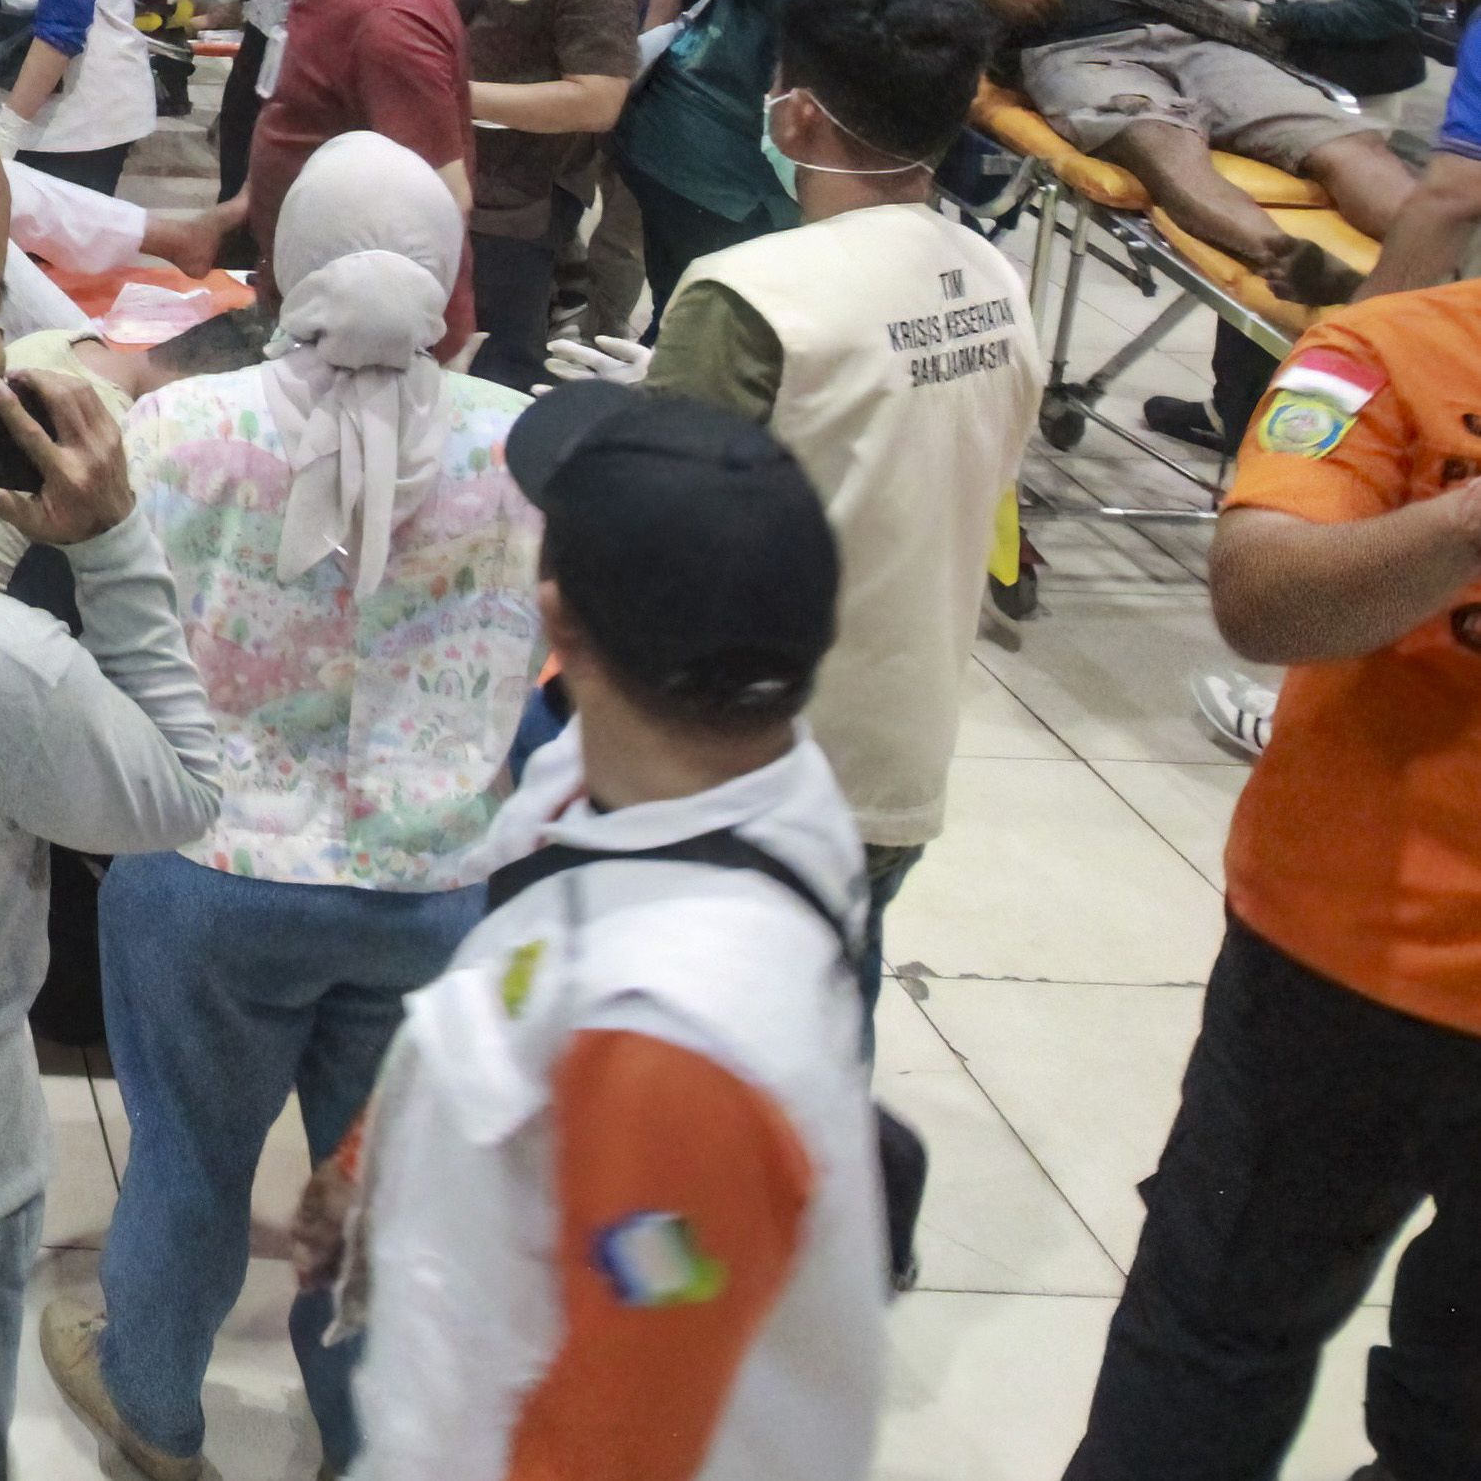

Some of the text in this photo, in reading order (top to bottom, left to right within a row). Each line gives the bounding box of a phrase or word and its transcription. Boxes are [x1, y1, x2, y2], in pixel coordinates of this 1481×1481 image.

[938, 269, 966, 300] TIM
[887, 298, 1016, 352] KRISIS KESEHATAN
[911, 338, 1010, 388] BANJARMASIN
